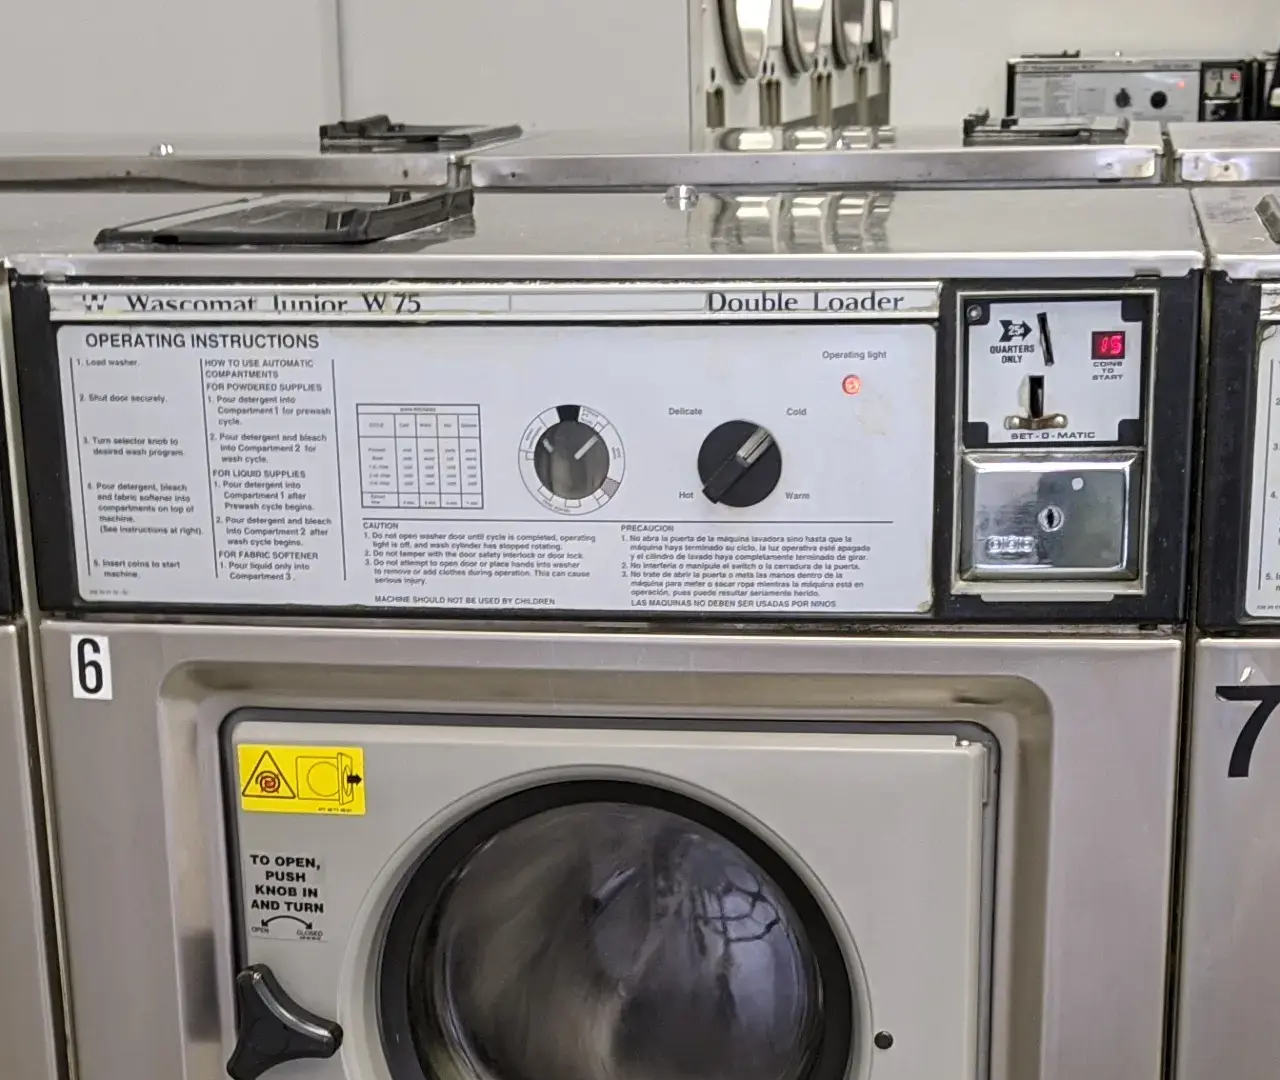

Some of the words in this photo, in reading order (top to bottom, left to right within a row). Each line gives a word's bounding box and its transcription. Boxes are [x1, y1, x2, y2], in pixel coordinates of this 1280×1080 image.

[127, 294, 257, 312] Wascomat
[272, 294, 348, 314] Junior
[362, 294, 385, 312] W
[394, 295, 421, 313] 75
[708, 292, 798, 312] Double
[813, 293, 904, 310] Loader
[86, 334, 185, 348] OPERATING
[191, 335, 319, 348] INSTRUCTIONS
[1100, 335, 1121, 354] 15
[822, 351, 865, 360] Operating
[867, 350, 886, 360] light
[990, 345, 1035, 354] QUARTERS
[263, 360, 313, 368] AUTOMATIC
[1001, 355, 1022, 364] ONLY
[207, 383, 223, 391] FOR
[227, 383, 277, 391] POWDERED
[280, 384, 322, 392] SUPPLIES
[786, 408, 806, 416] Cold
[77, 638, 103, 694] 6
[250, 855, 270, 866] TO
[275, 857, 320, 869] OPEN,
[265, 871, 306, 882] PUSH
[255, 885, 297, 896] KNOB
[302, 887, 318, 897] IN
[251, 900, 280, 910] AND
[285, 901, 324, 913] TURN
